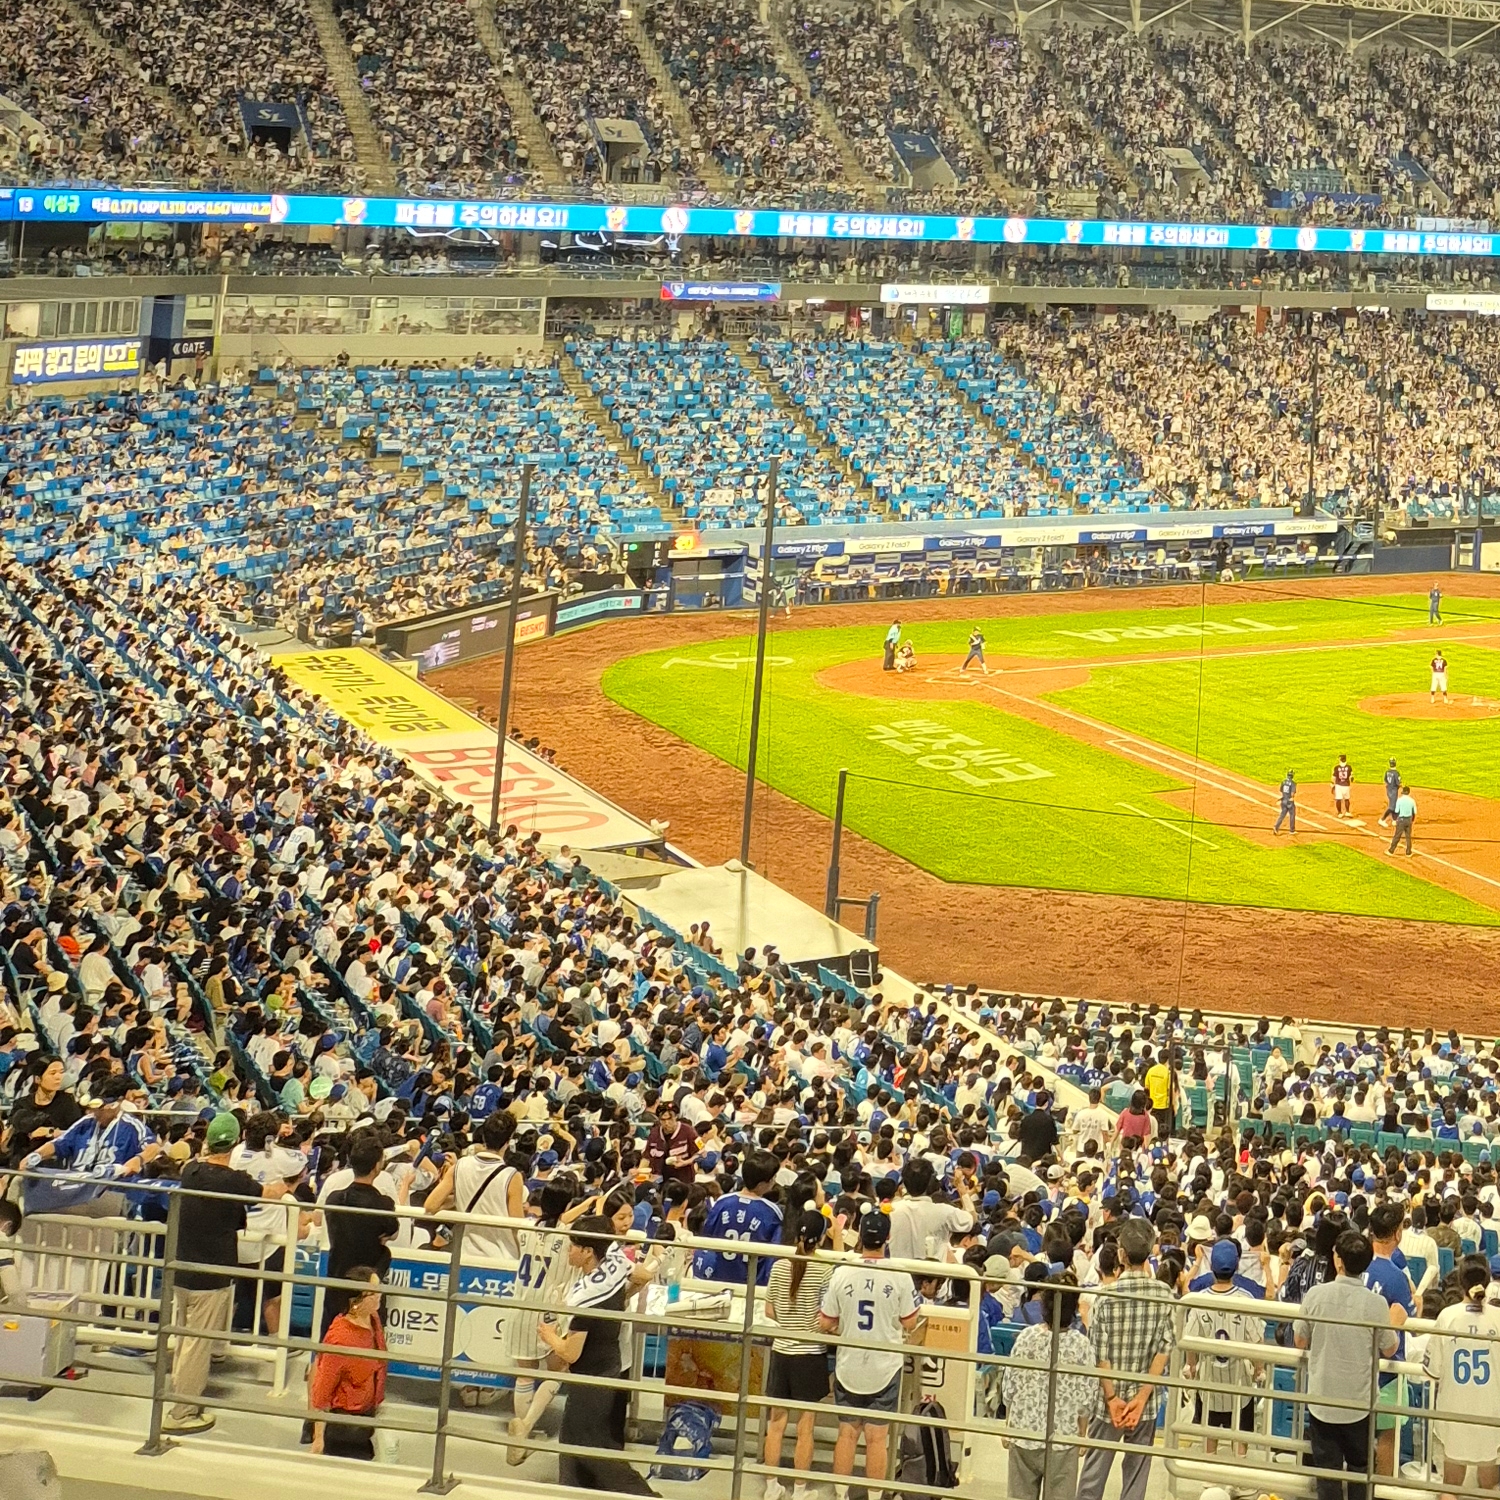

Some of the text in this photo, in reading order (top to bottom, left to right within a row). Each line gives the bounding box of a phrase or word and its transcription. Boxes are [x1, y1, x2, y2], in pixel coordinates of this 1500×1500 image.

[45, 346, 74, 376] 광고
[74, 344, 103, 373] 문의
[866, 719, 1057, 787] 백조씽크
[405, 746, 609, 834] BESKO
[518, 1253, 551, 1289] 47
[386, 1308, 439, 1332] 이온즈
[857, 1300, 876, 1331] 5
[1453, 1349, 1490, 1386] 65
